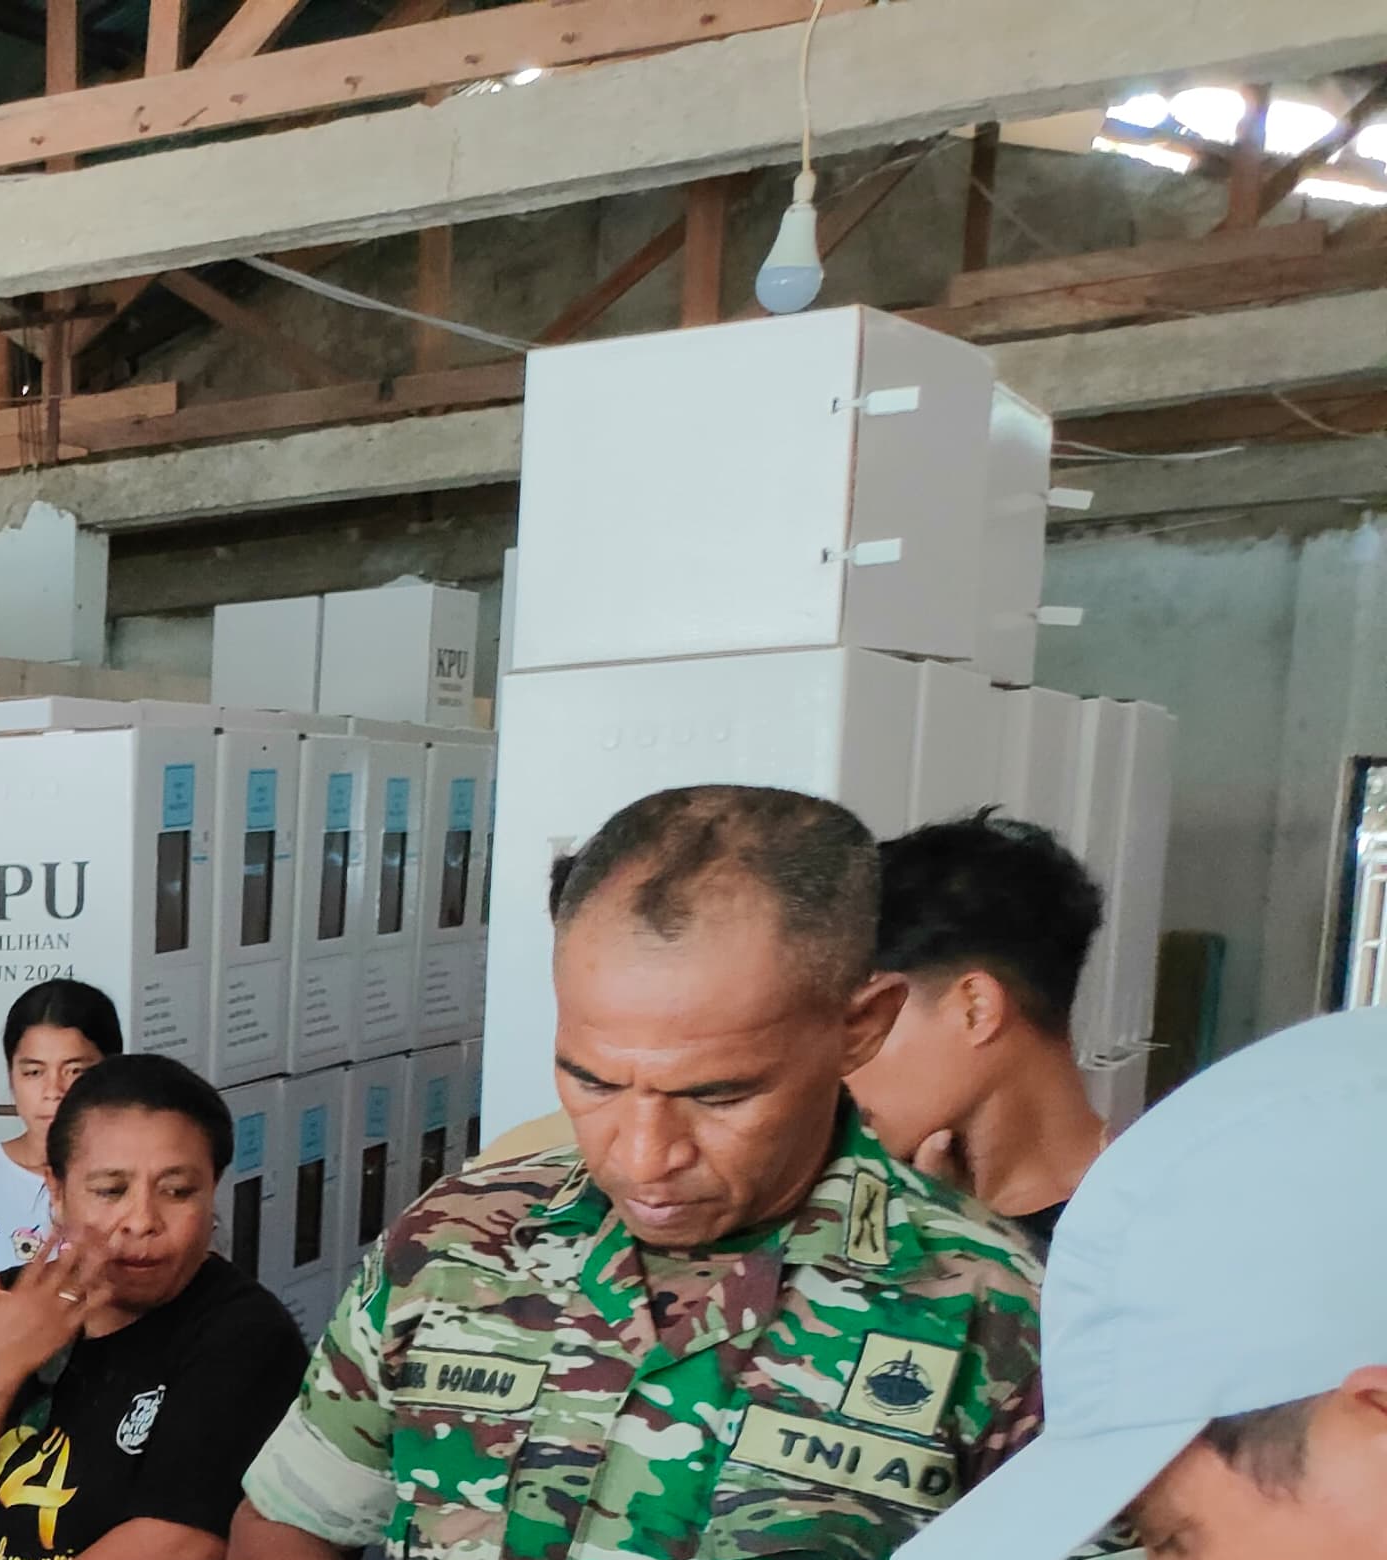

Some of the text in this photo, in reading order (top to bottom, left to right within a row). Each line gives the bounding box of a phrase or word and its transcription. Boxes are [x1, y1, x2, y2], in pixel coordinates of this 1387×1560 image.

[24, 963, 75, 981] 2024
[778, 1427, 953, 1497] TNI AD
